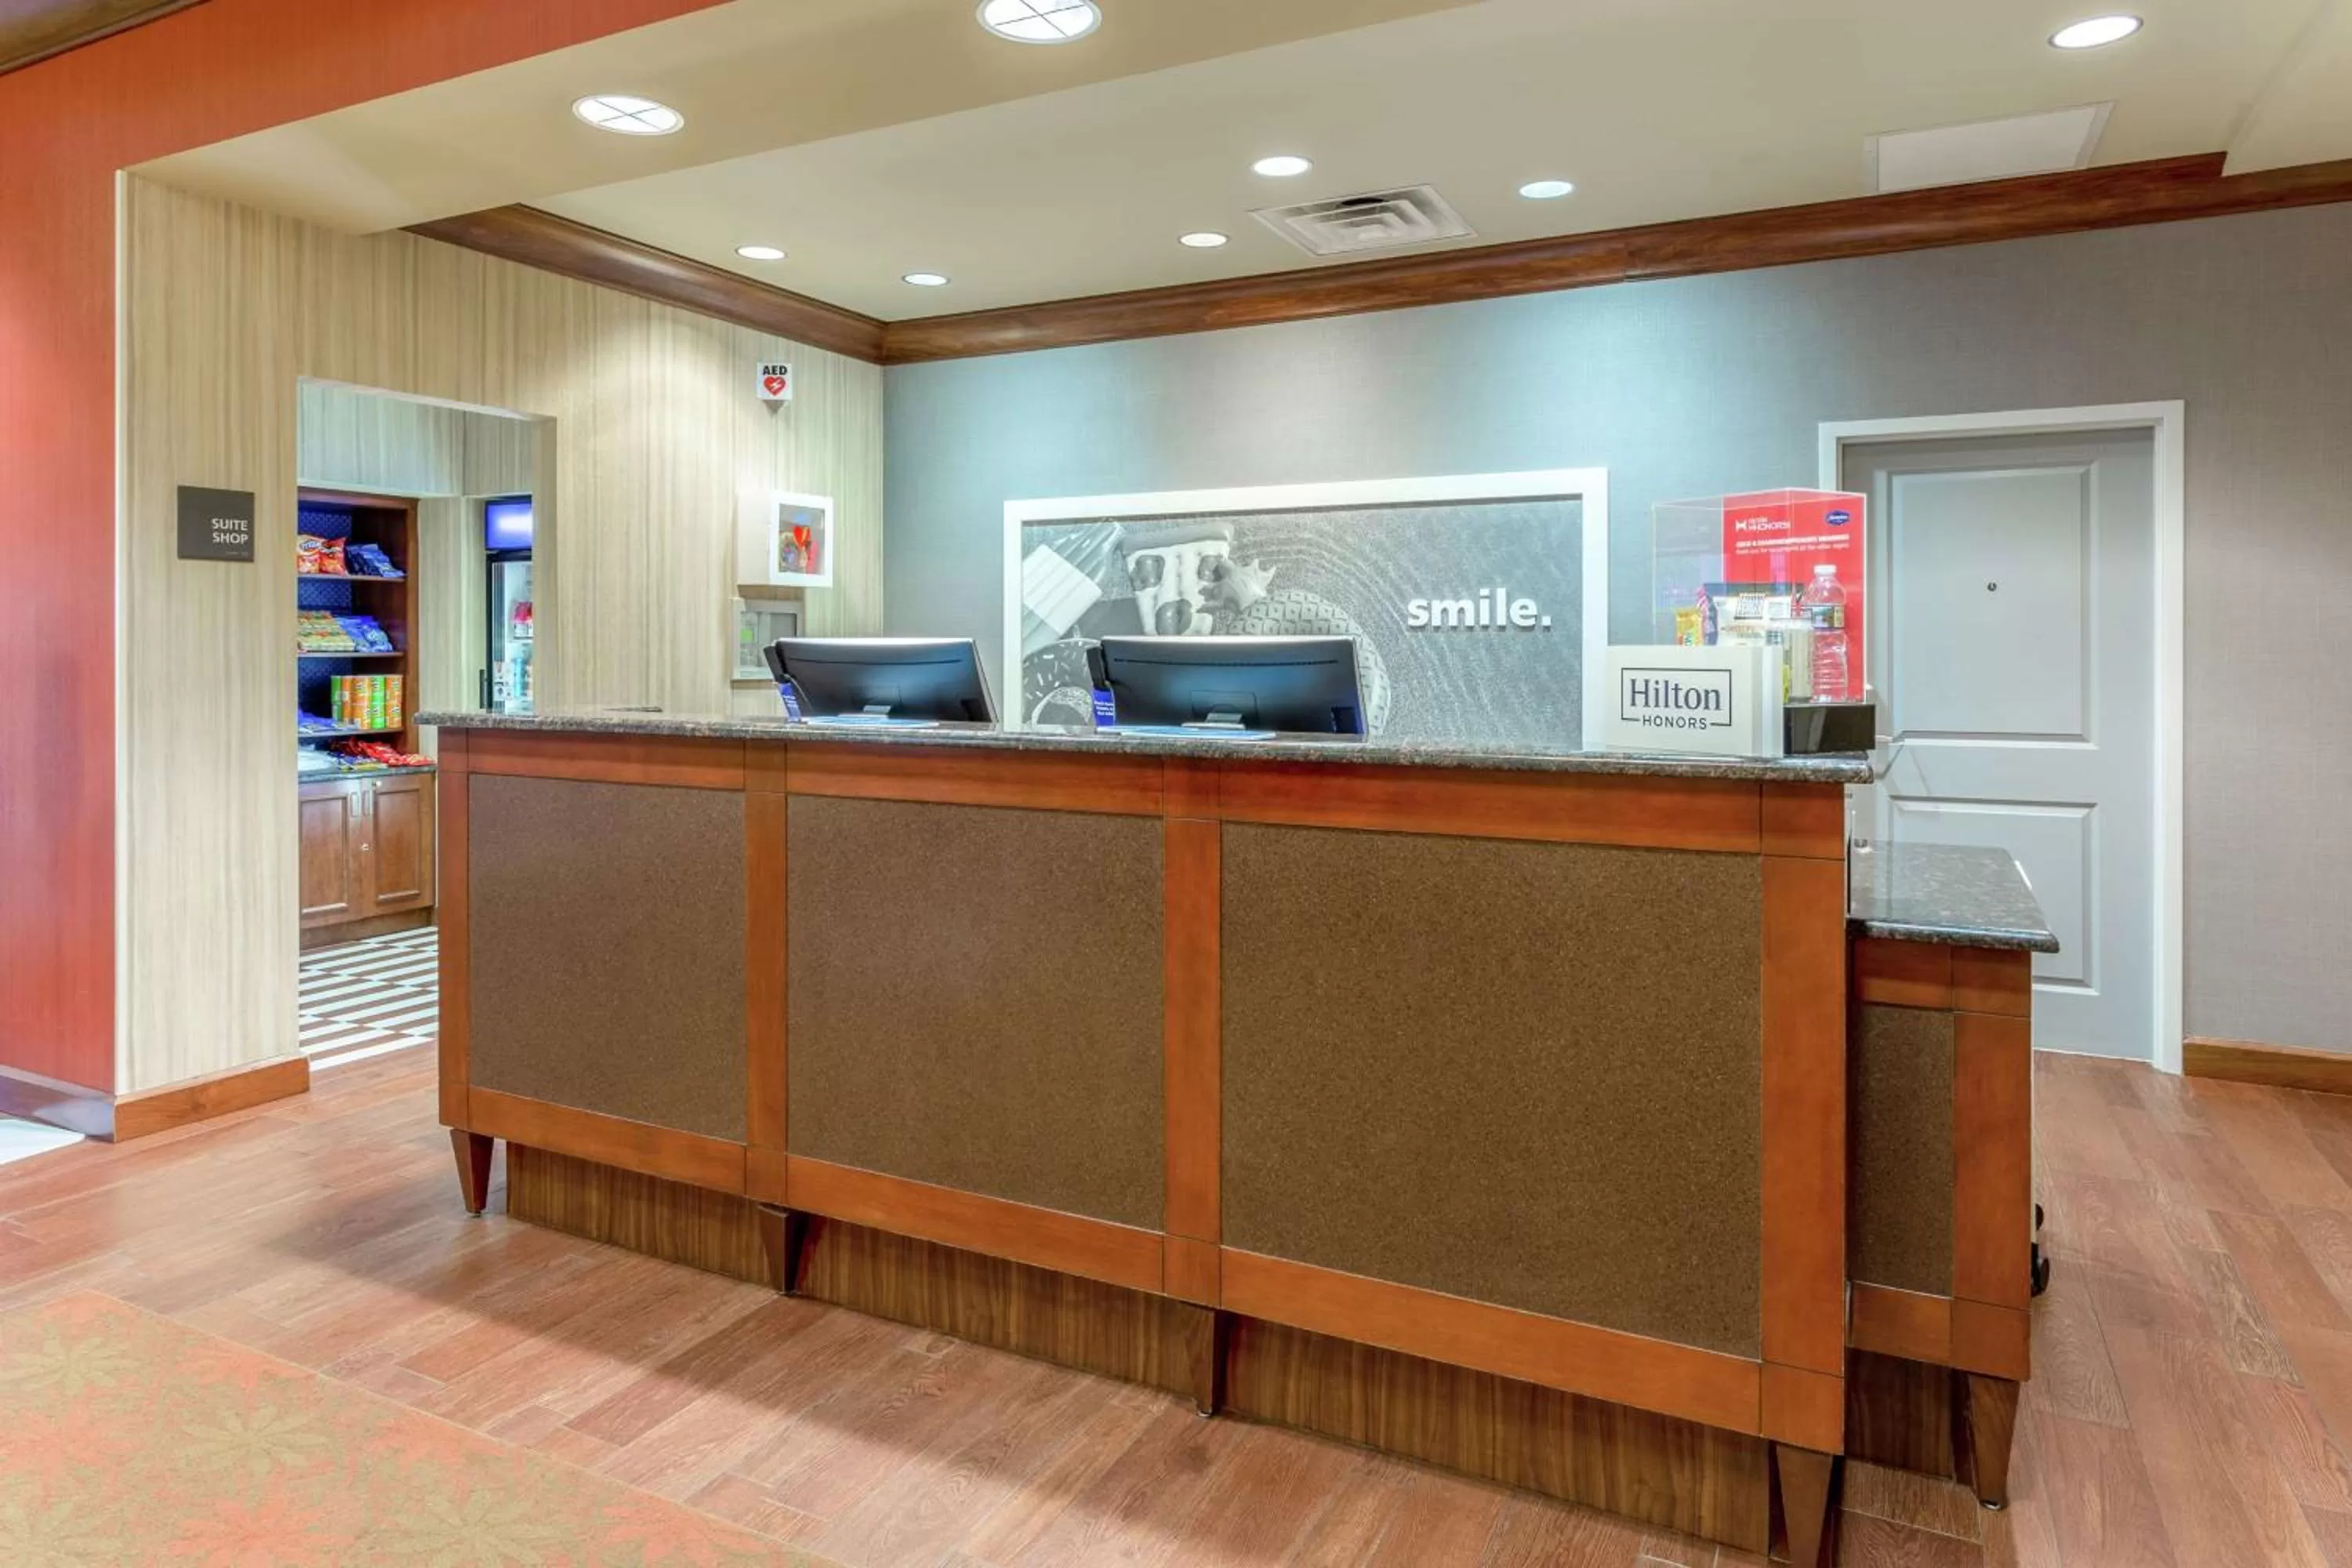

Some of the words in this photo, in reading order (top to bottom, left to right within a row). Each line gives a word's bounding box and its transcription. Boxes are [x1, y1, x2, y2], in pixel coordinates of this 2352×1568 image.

[763, 365, 788, 376] AED
[212, 518, 249, 531] SUITE
[212, 532, 249, 544] SHOP
[1407, 587, 1552, 629] smile.
[1630, 678, 1722, 710] Hilton
[1642, 715, 1707, 730] HONORS
